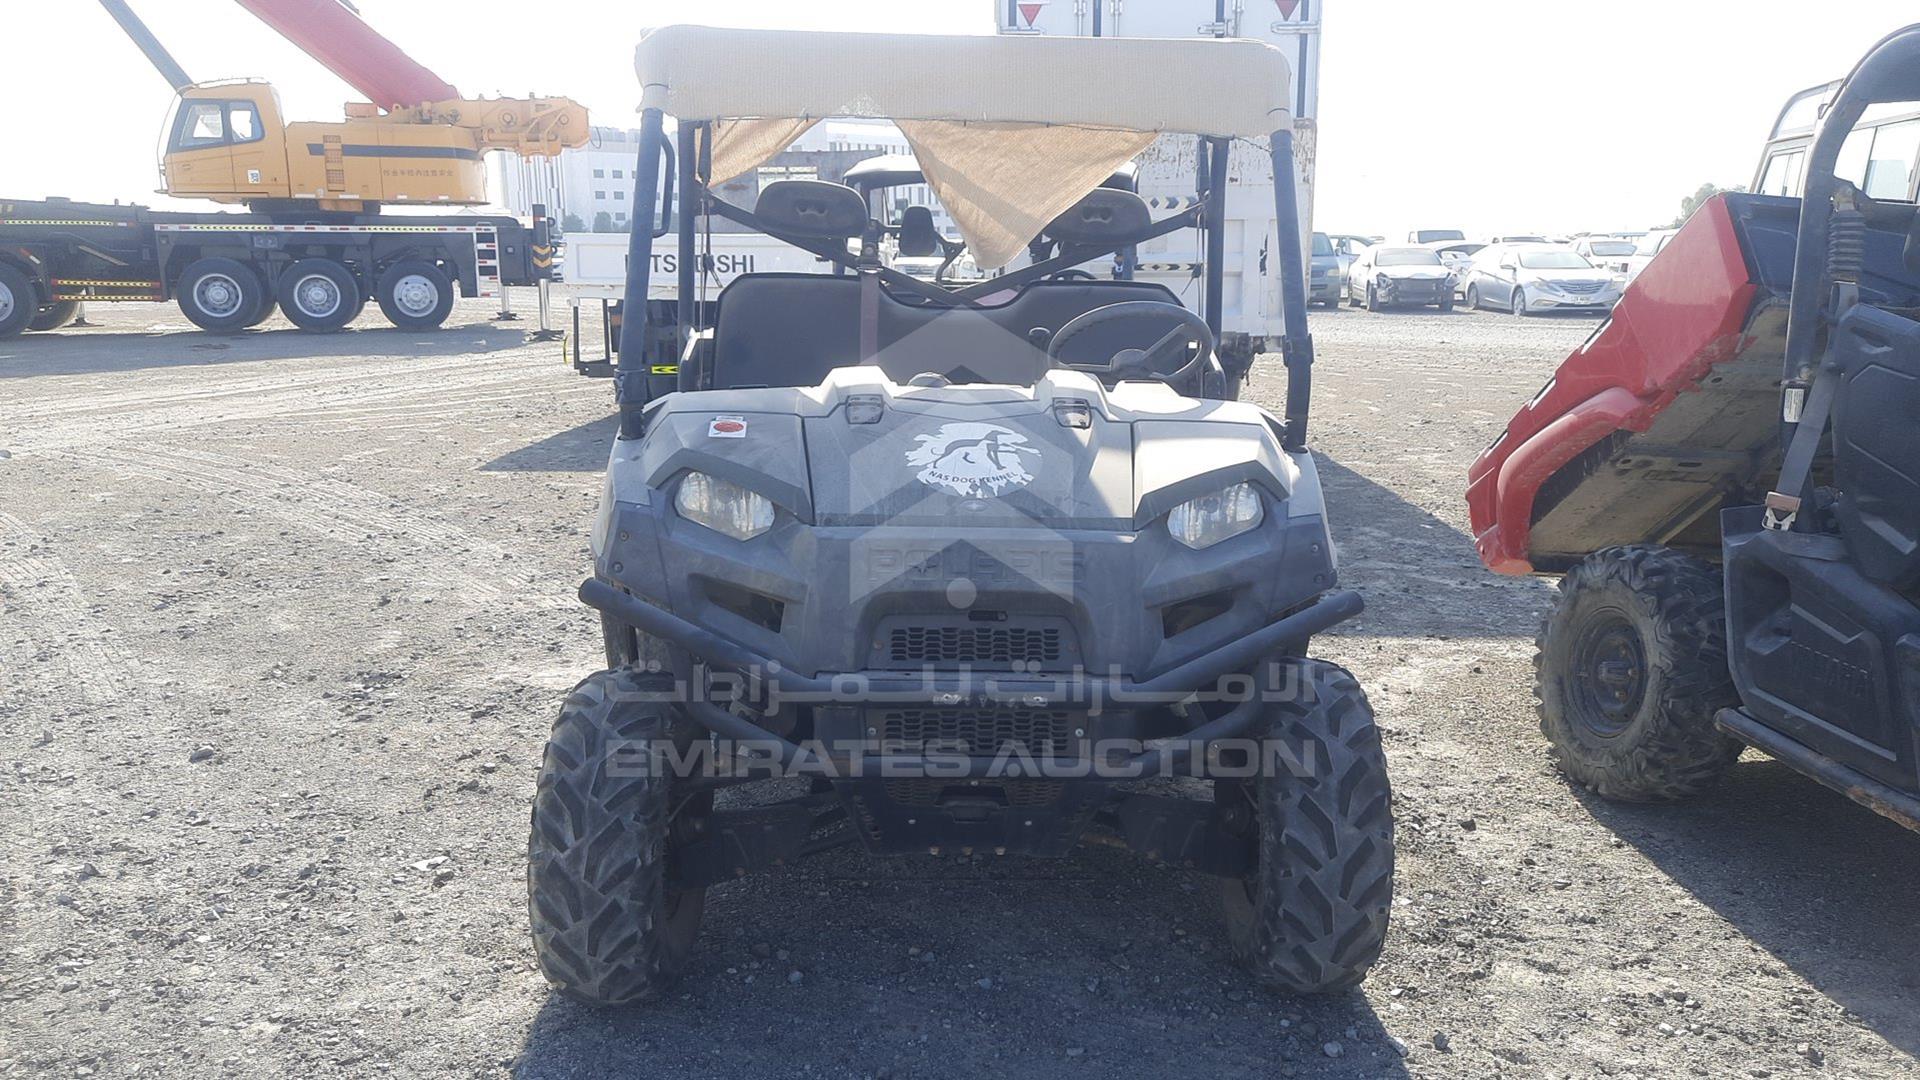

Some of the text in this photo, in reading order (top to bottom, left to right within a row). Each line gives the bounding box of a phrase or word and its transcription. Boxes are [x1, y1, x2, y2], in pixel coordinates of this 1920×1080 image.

[624, 254, 754, 273] TSSHI
[928, 470, 1019, 484] NAS DOG KENNEL
